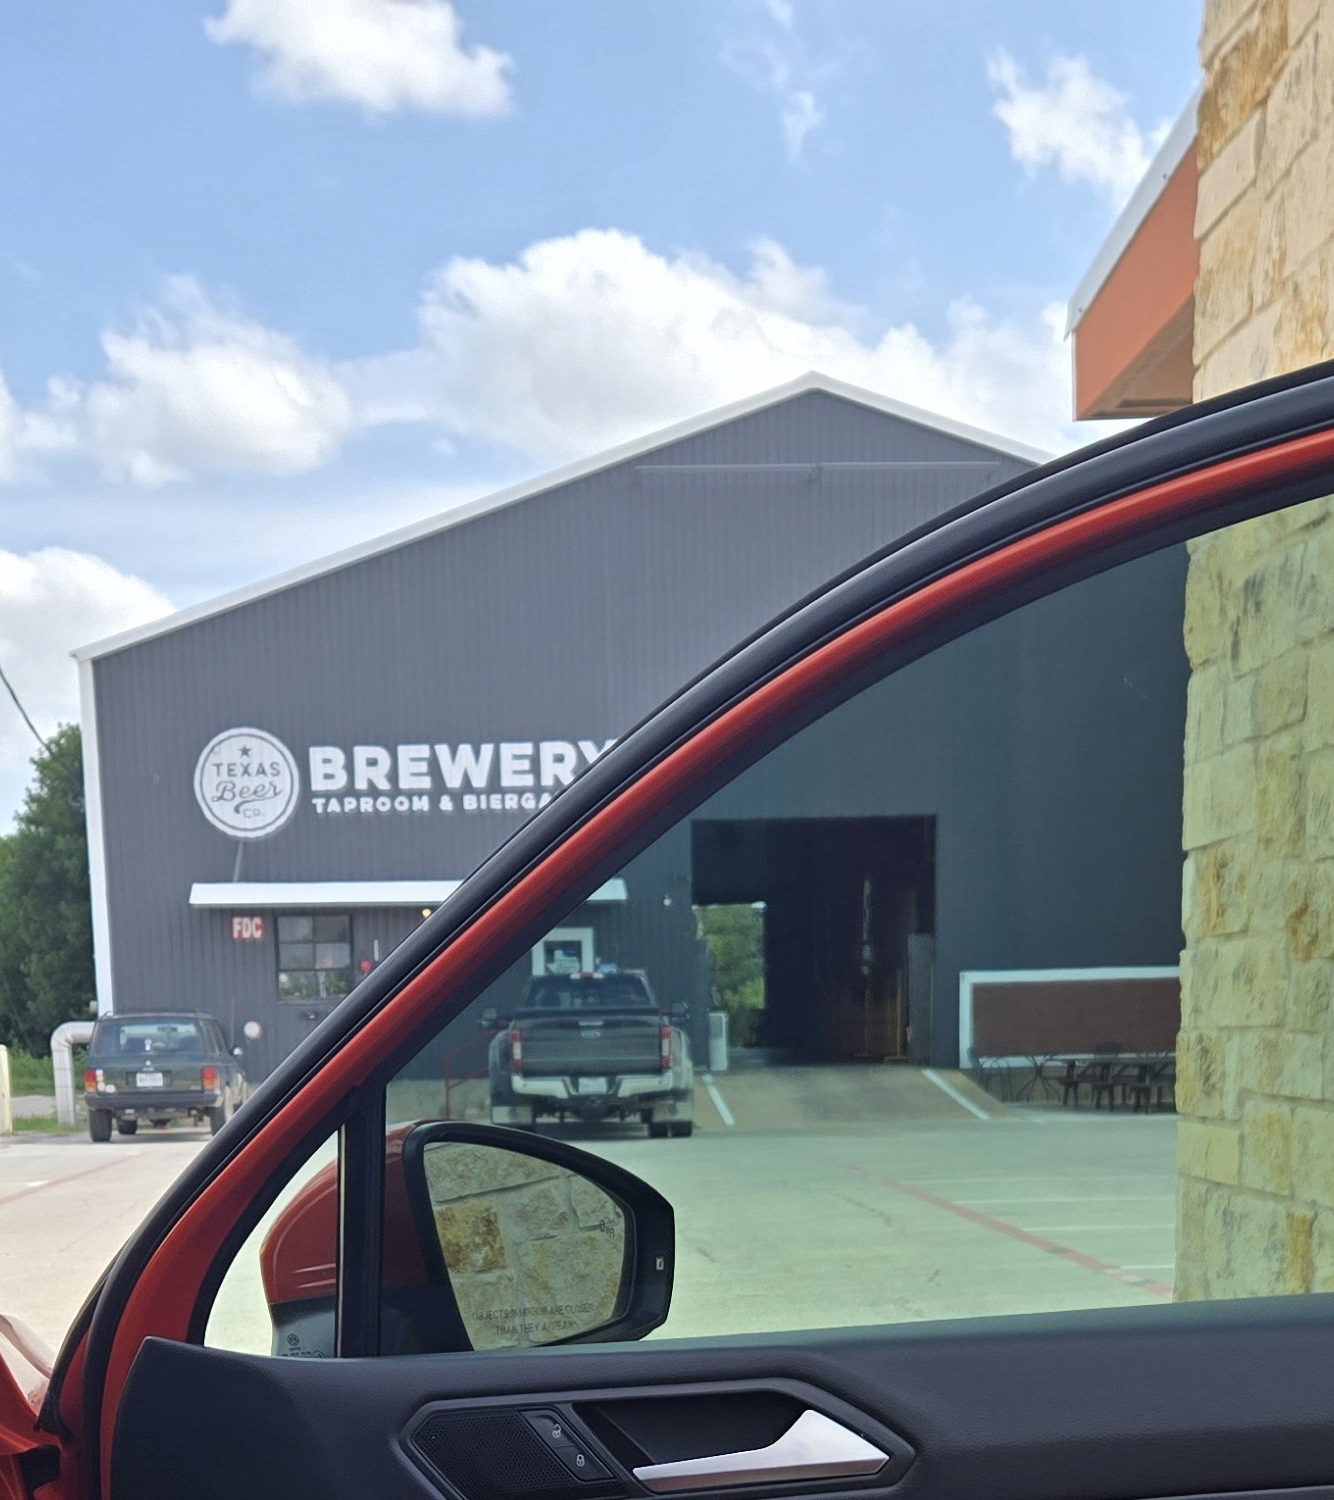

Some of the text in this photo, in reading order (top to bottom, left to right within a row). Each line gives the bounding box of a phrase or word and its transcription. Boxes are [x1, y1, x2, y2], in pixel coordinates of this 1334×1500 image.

[212, 761, 281, 777] TEXAS
[211, 780, 283, 813] Beer
[312, 795, 430, 813] TAPROOM
[439, 794, 453, 811] &
[232, 916, 262, 939] FDC
